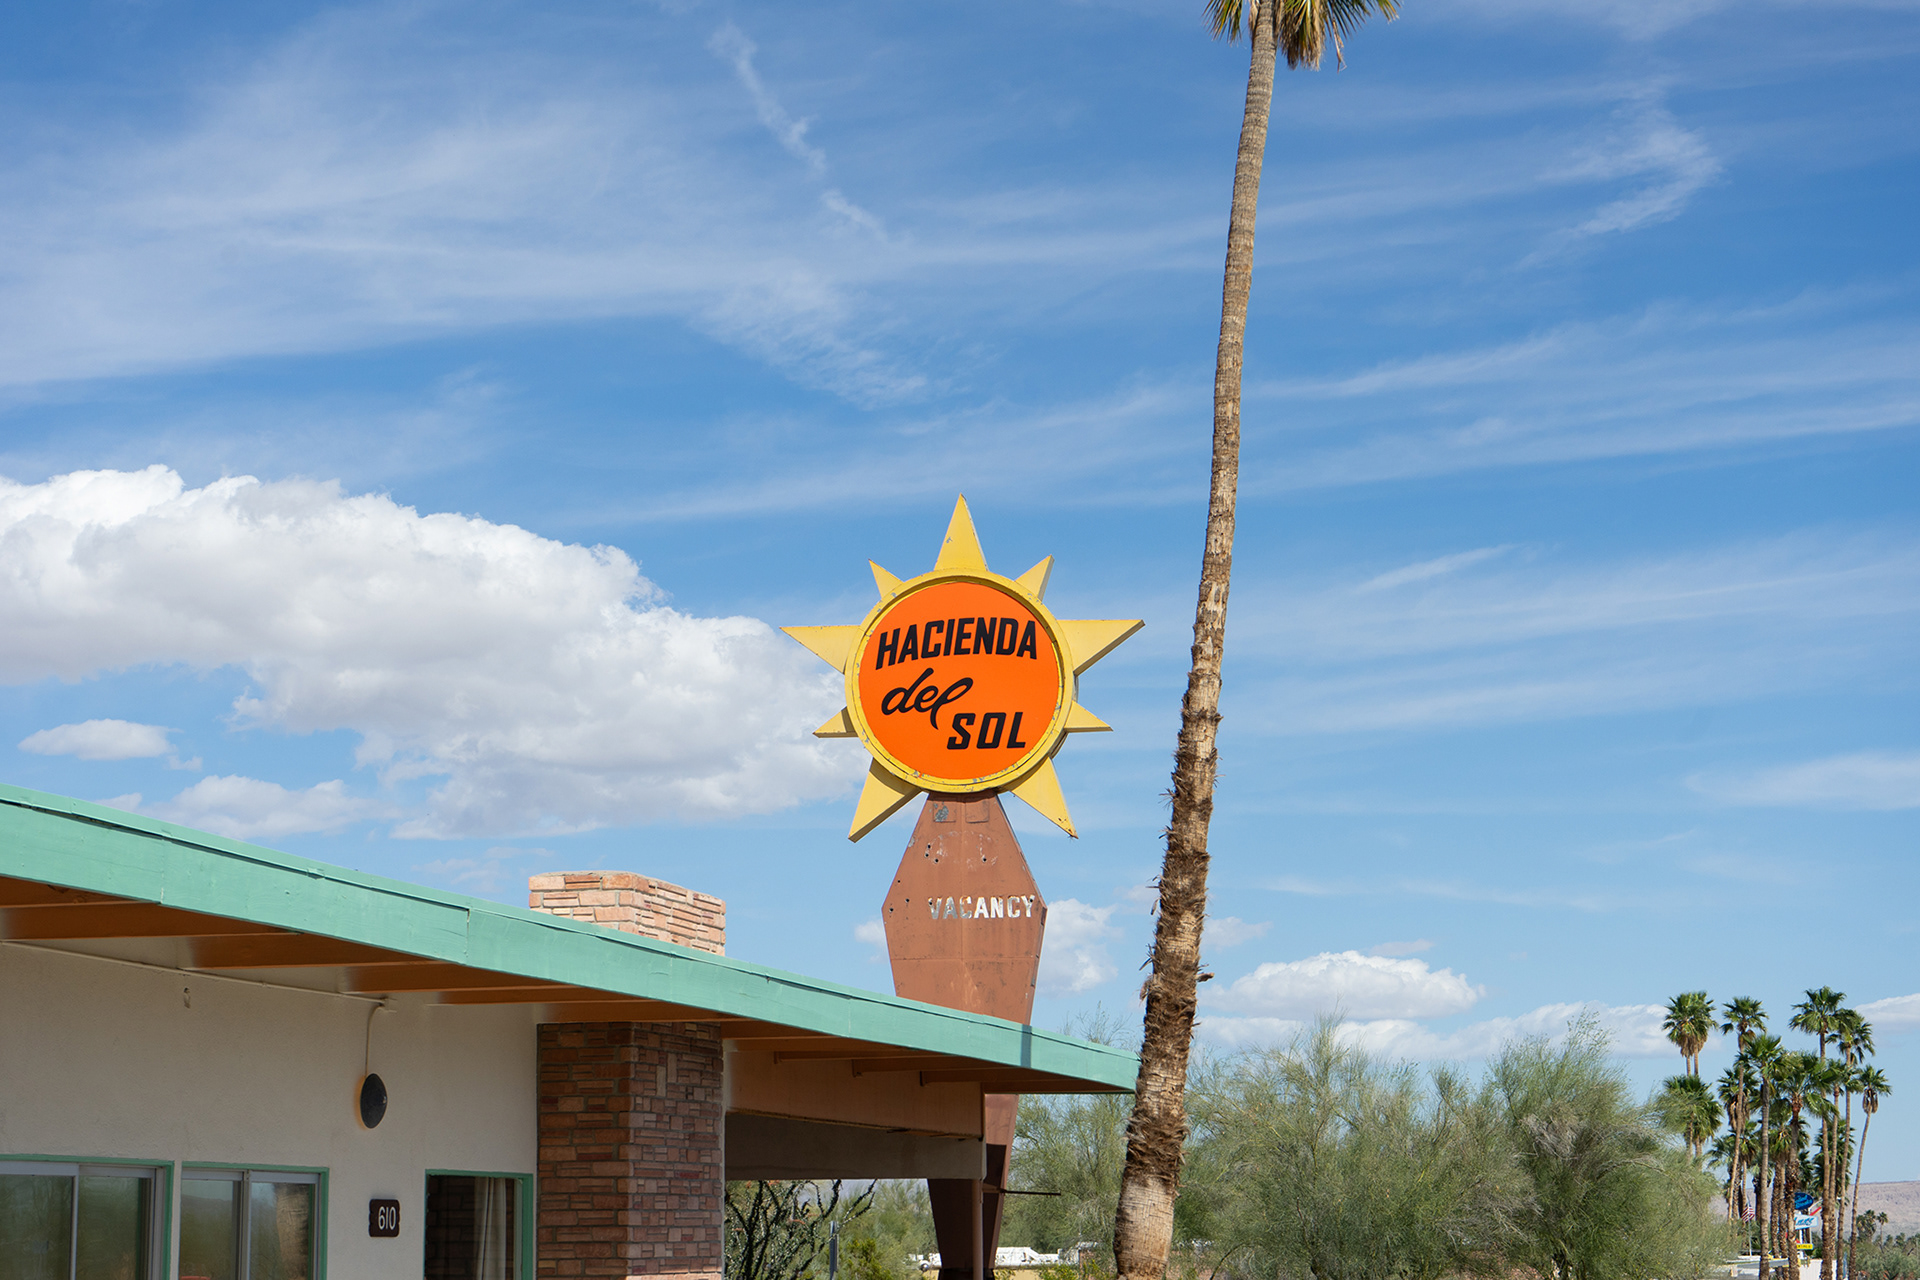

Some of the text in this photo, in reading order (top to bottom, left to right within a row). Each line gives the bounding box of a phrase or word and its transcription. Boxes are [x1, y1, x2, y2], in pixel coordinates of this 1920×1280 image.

[875, 617, 1037, 670] HACIENDA
[881, 667, 974, 730] del
[946, 711, 1026, 750] SOL
[927, 894, 1035, 919] VACANCY
[378, 1206, 397, 1230] 610
